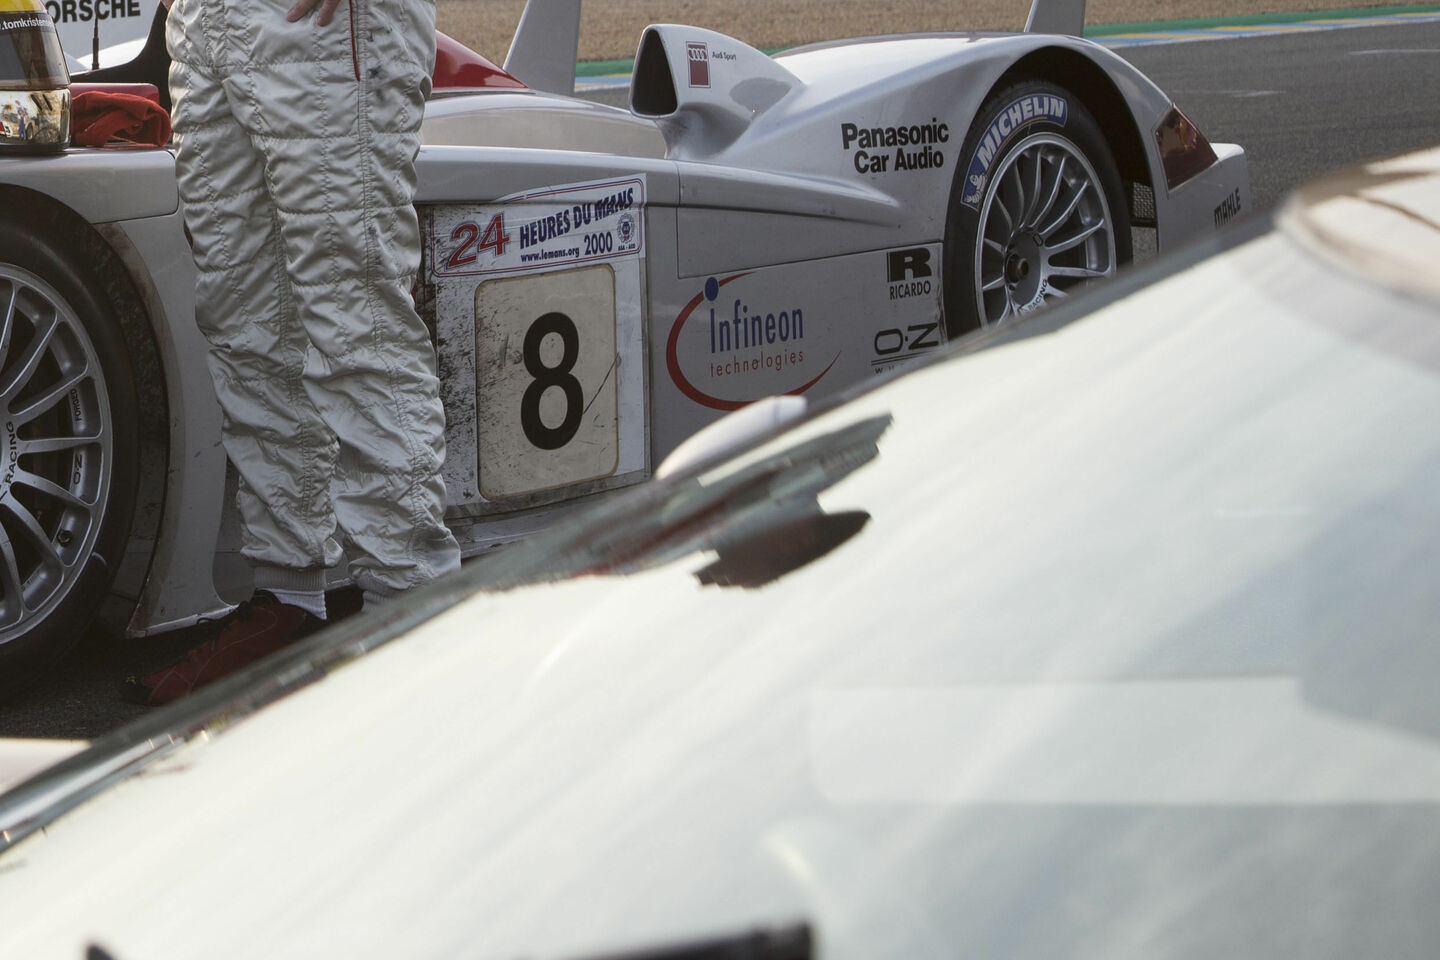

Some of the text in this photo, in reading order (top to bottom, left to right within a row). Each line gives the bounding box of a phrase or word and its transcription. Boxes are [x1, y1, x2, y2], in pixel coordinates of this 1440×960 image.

[841, 117, 949, 150] Panasonic
[976, 95, 1065, 171] MICHELIN
[854, 146, 944, 174] Car Audio
[1214, 186, 1241, 231] MAHLE
[446, 187, 634, 271] 24 HEURES DU MANS
[520, 231, 613, 263] www.lemans.org 2000
[887, 248, 932, 282] R
[890, 280, 931, 301] RICARDO
[710, 299, 803, 354] Infineon
[521, 311, 584, 451] 8
[710, 349, 804, 378] technologies
[5, 421, 17, 484] RACING
